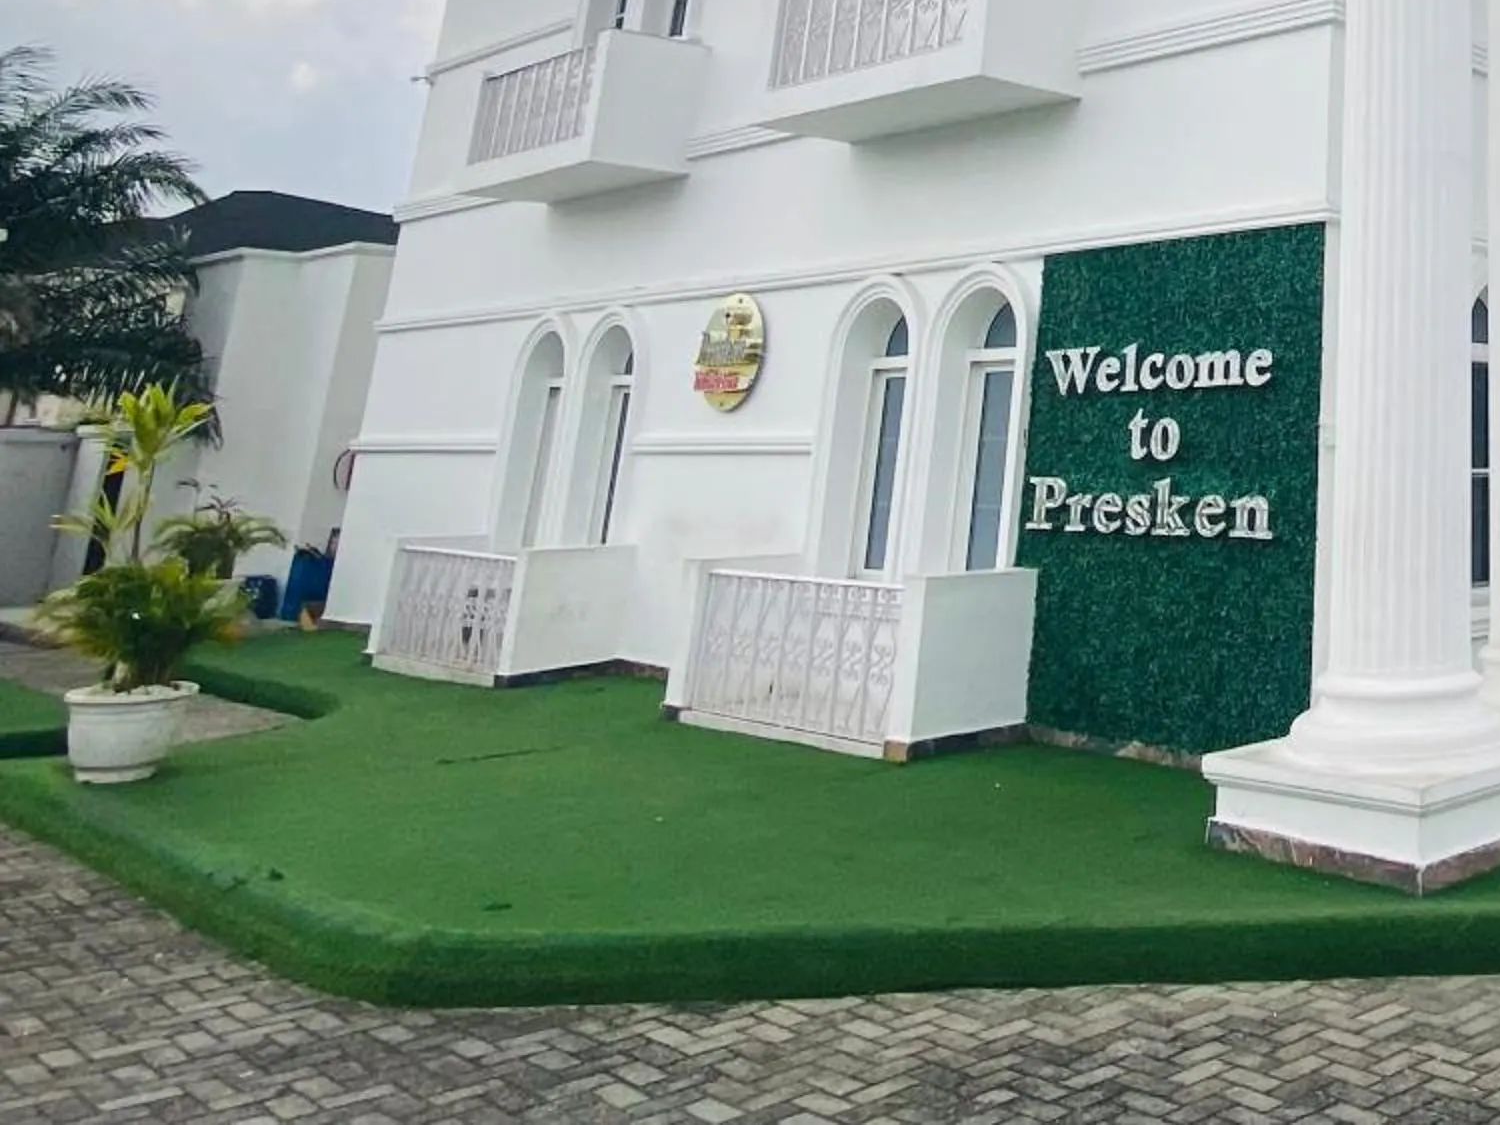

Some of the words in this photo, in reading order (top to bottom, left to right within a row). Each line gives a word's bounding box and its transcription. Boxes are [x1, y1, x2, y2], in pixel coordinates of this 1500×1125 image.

[1046, 342, 1273, 395] Welcome
[1128, 408, 1181, 460] to
[1025, 477, 1273, 540] Presken
